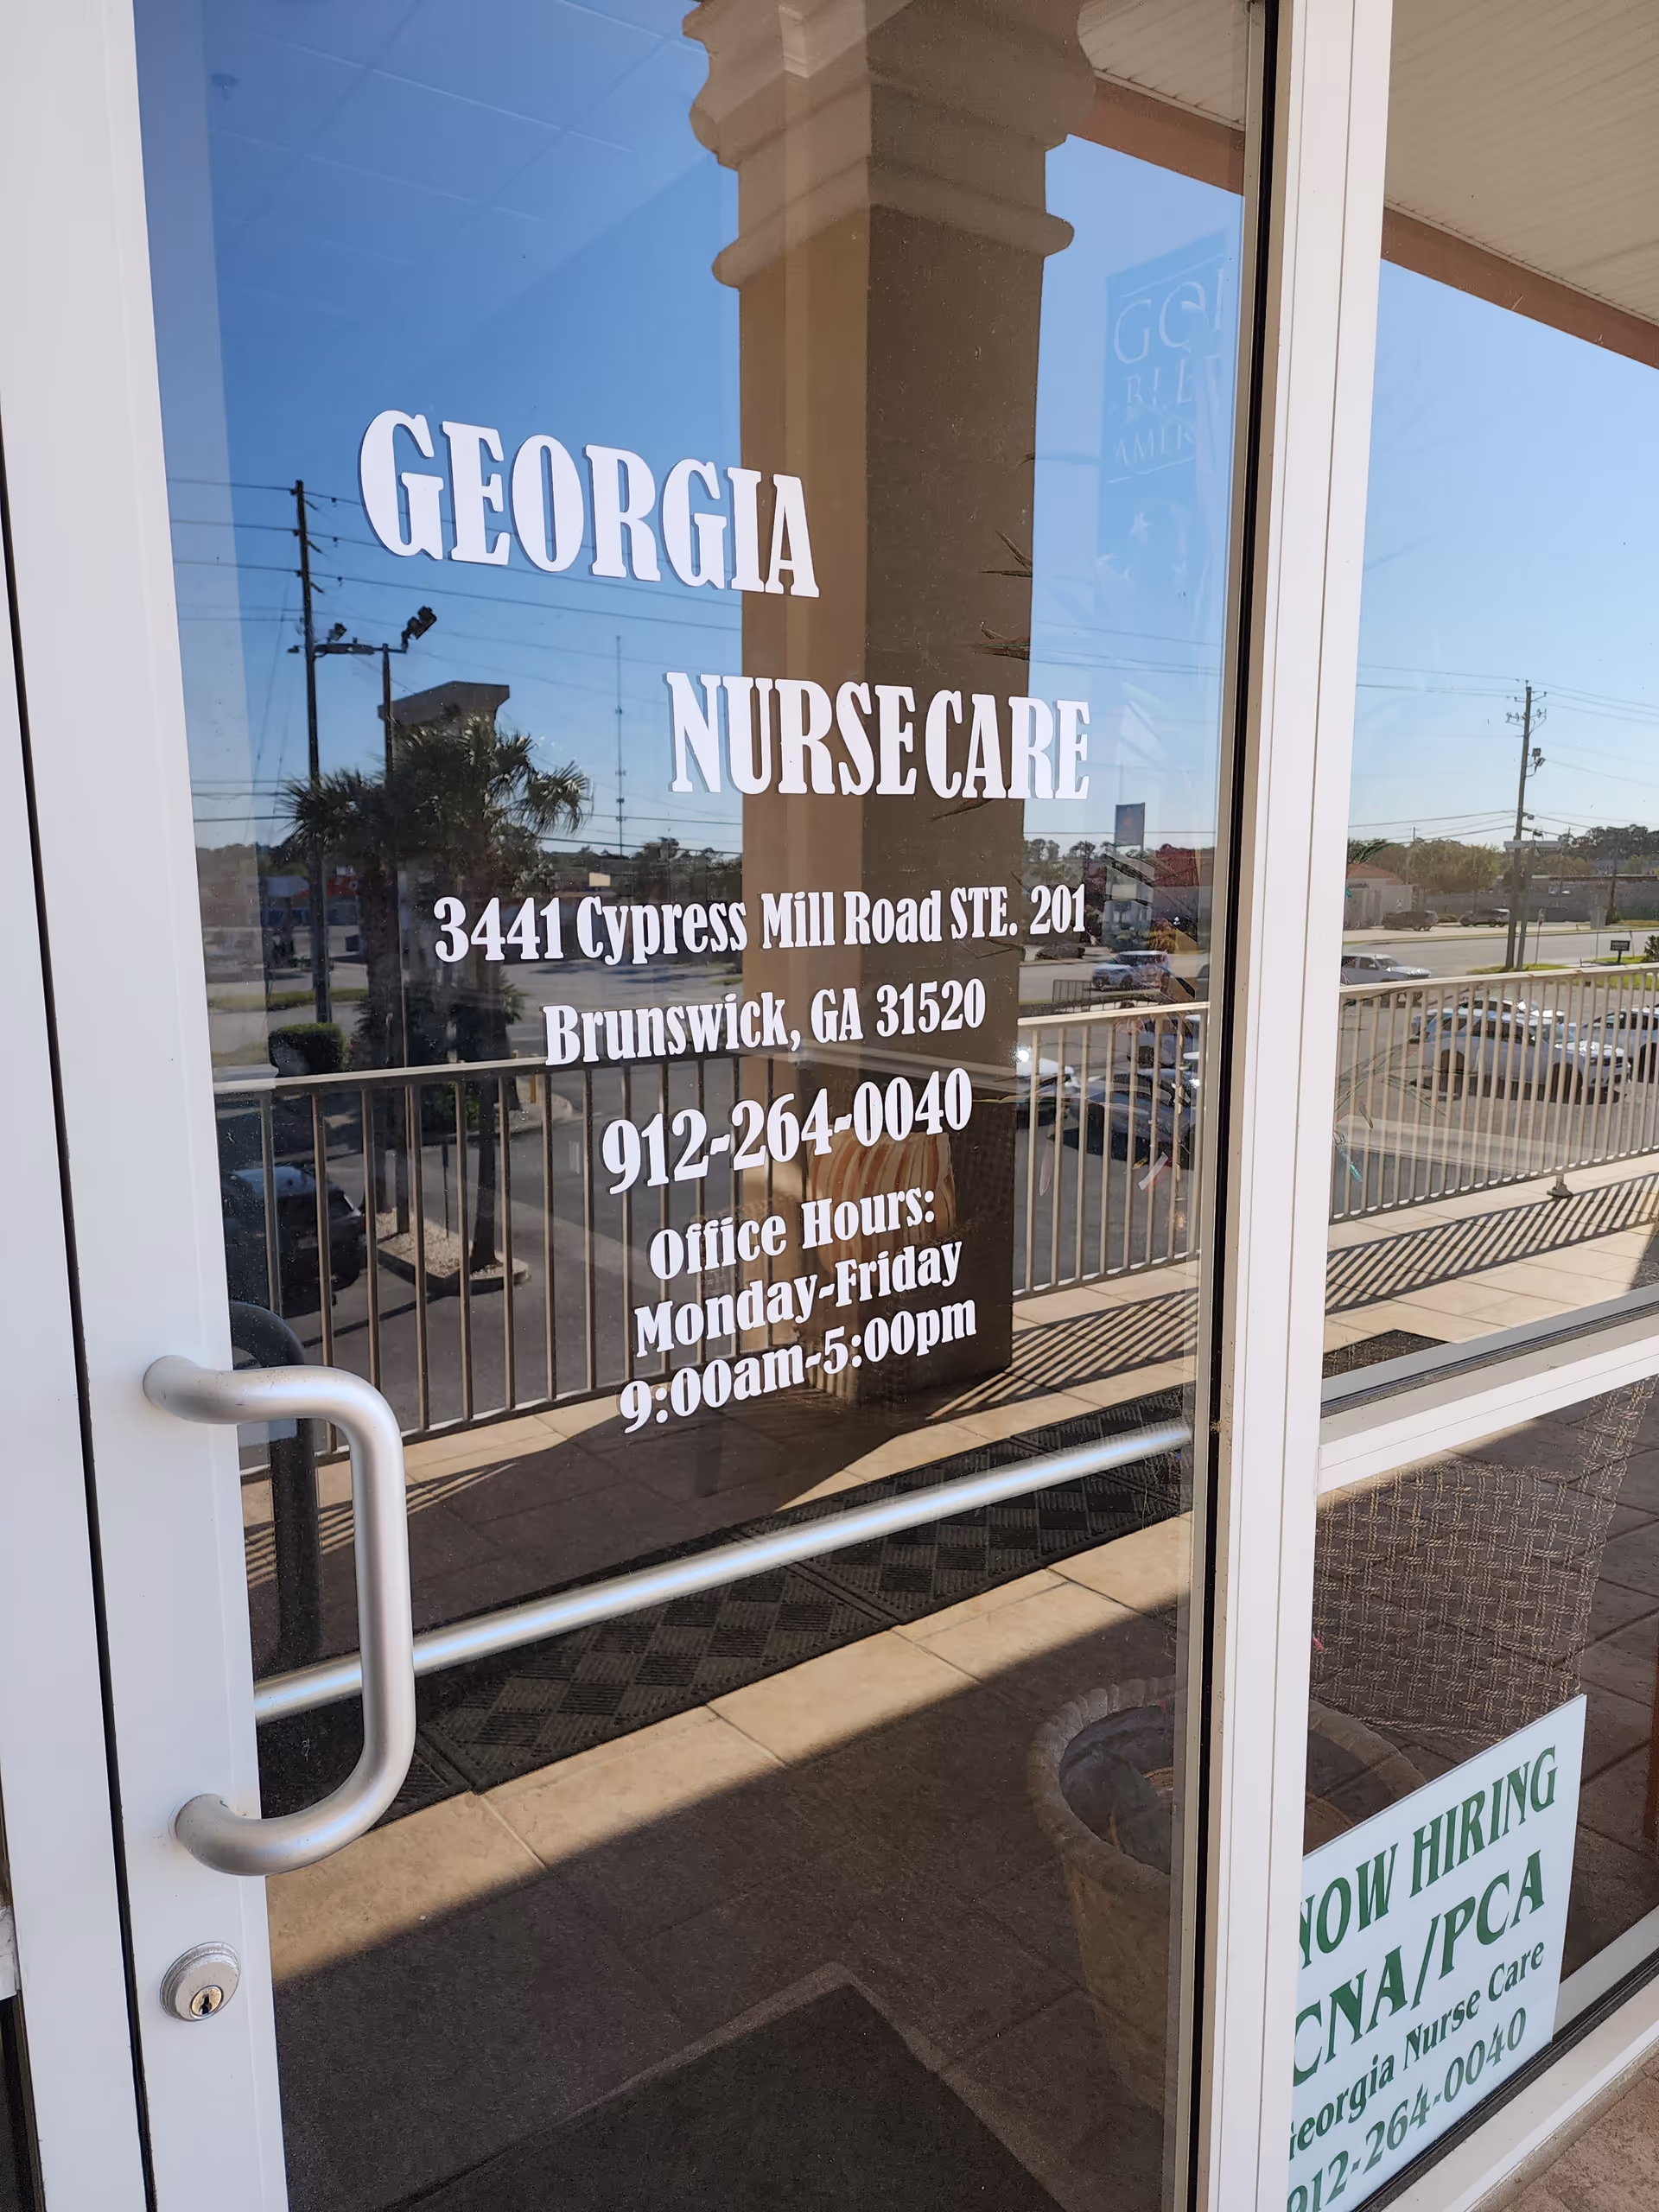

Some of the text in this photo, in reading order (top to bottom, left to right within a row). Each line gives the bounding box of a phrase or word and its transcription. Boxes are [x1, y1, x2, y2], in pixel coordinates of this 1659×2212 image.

[360, 409, 820, 599] GEORGIA
[434, 884, 1085, 966] 3441 Cypress Mill Road STE. 201
[543, 978, 986, 1065] Brunswick, GA 31520
[602, 1067, 973, 1195] 912-264-0040
[650, 1186, 935, 1280] Office Hours:
[634, 1241, 963, 1358] Monday-Friday
[620, 1299, 977, 1434] 9:00am-5:00pm
[1409, 1745, 1558, 1898] HIRING
[1293, 1849, 1545, 2087] CNA/PCA
[1289, 1942, 1545, 2162] eorgia Nurse Care
